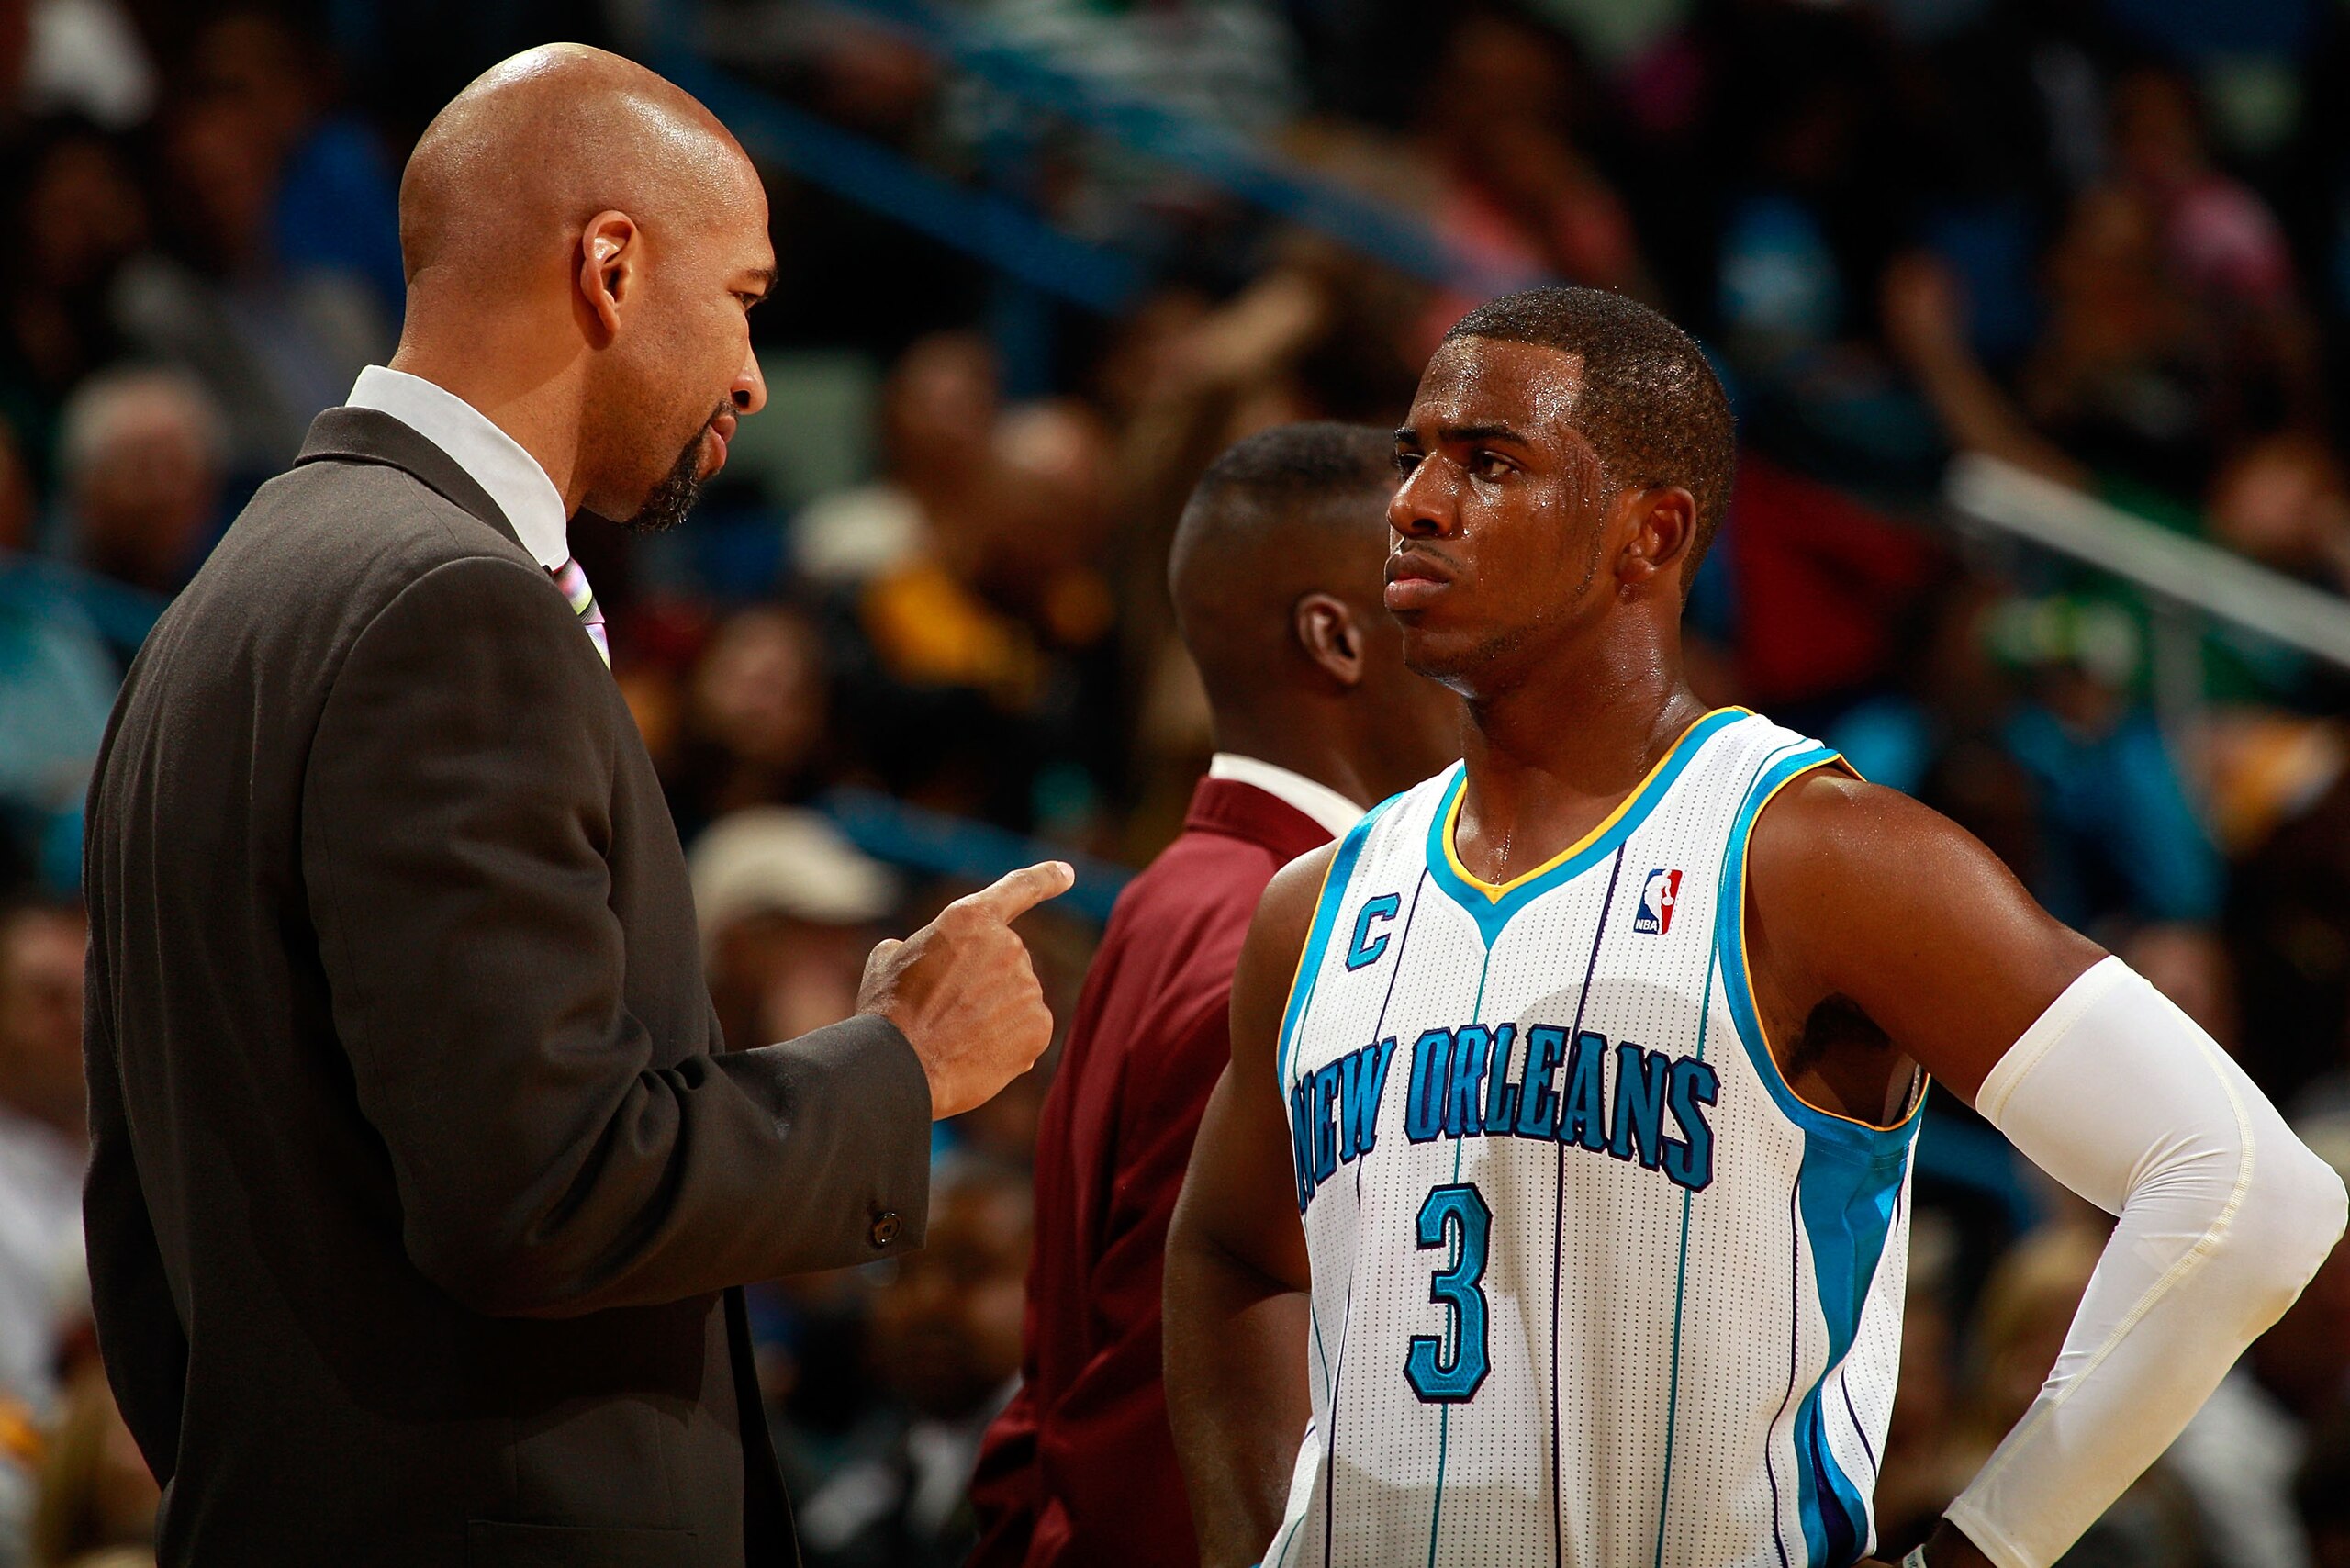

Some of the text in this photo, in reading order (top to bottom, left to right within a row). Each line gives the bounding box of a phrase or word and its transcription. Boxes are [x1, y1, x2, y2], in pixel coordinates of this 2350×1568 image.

[1347, 892, 1401, 971] C
[1635, 919, 1658, 931] NBA
[1291, 1023, 1721, 1215] NEW ORLEANS
[1404, 1182, 1492, 1403] 3
